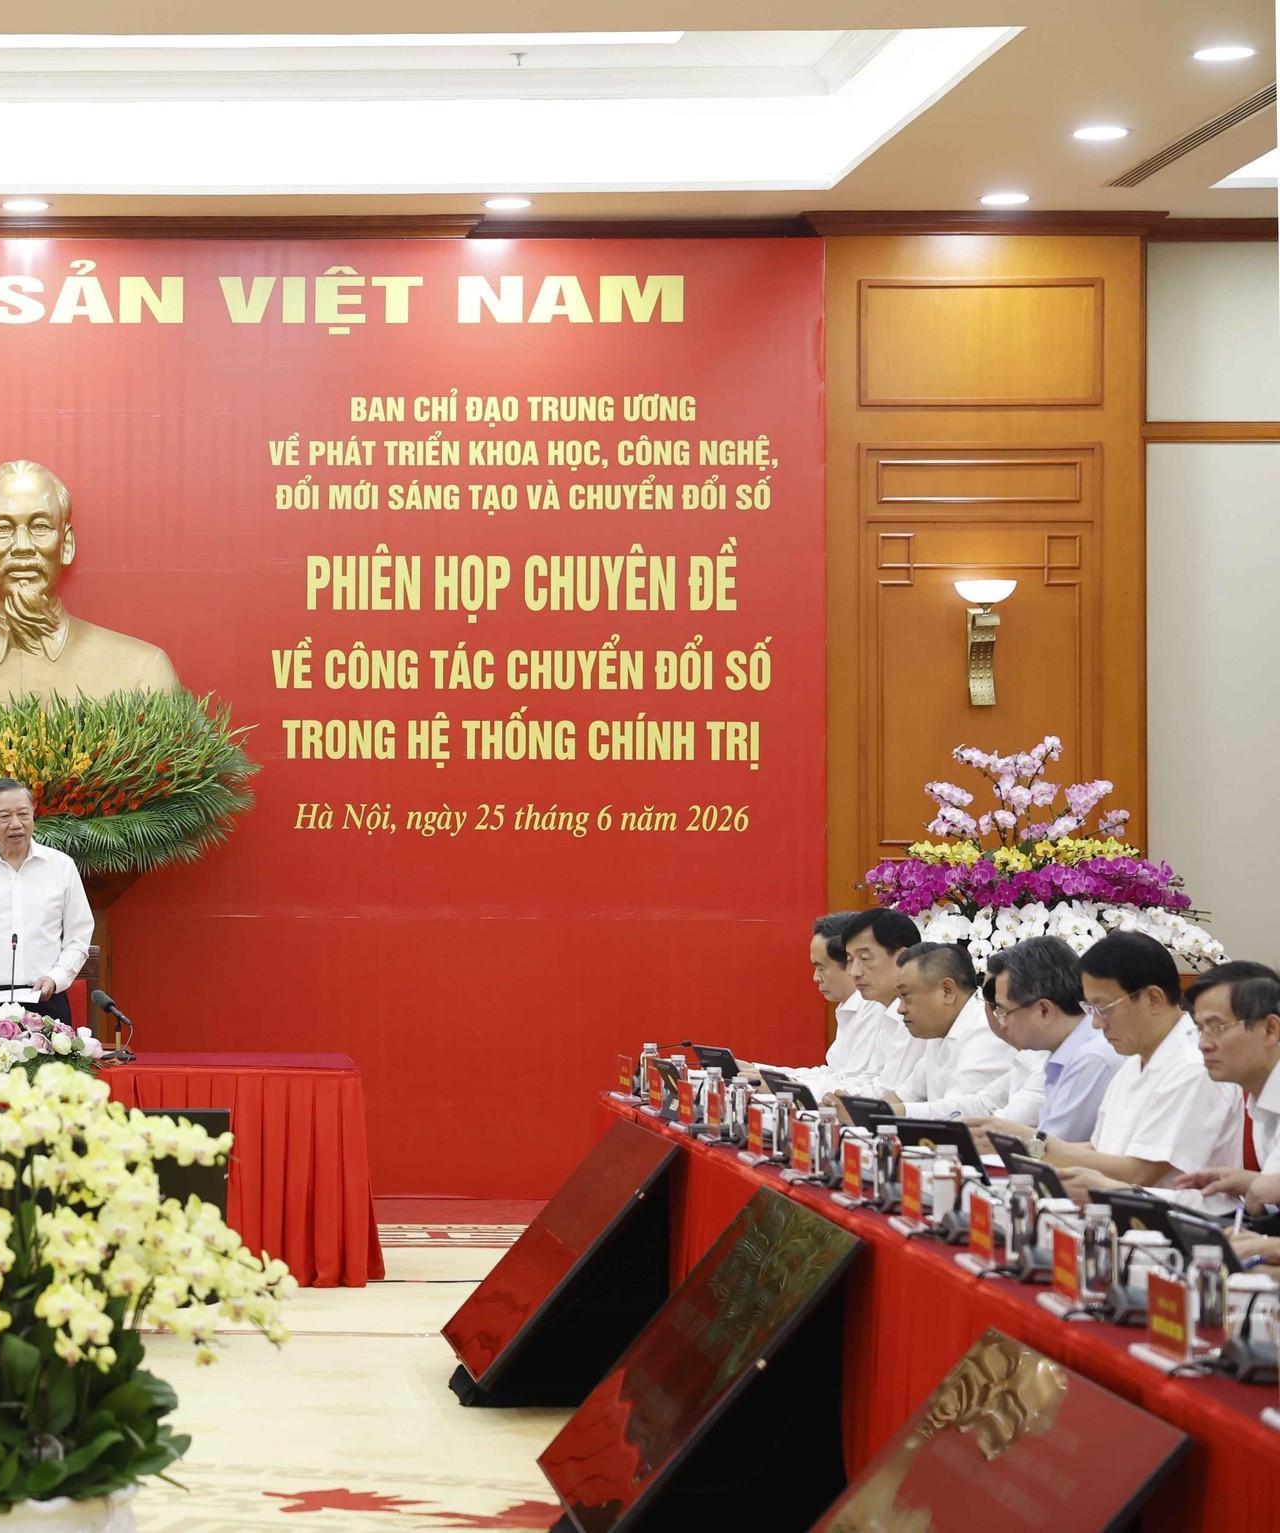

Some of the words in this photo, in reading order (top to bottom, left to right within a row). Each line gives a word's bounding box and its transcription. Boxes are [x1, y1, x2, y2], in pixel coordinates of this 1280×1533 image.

[220, 266, 423, 335] VIỆT
[458, 275, 685, 324] NAM
[351, 397, 404, 421] BAN
[414, 388, 458, 422] CHỈ
[465, 396, 518, 427] ĐẠO
[527, 396, 614, 421] TRUNG
[624, 394, 695, 421] ƯƠNG
[269, 432, 299, 465] VỀ
[309, 436, 376, 465] PHÁT
[384, 431, 459, 465] TRIỂN
[469, 441, 539, 466] KHOA
[548, 440, 608, 471] HỌC,
[618, 435, 689, 465] CÔNG
[700, 435, 778, 471] NGHỆ,
[275, 475, 319, 510] ĐỔI
[329, 480, 378, 510] MỚI
[388, 480, 459, 510] SÁNG
[469, 485, 517, 515] TẠO
[527, 480, 560, 509] VÀ
[569, 475, 673, 510] CHUYỂN
[682, 475, 726, 509] ĐỔI
[736, 476, 771, 509] SỐ
[307, 544, 420, 610] PHIÊN
[435, 555, 510, 623] HỌP
[525, 544, 675, 611] CHUYÊN
[689, 537, 738, 610] ĐỀ
[272, 637, 312, 688] VỀ
[325, 642, 418, 689] CÔNG
[430, 642, 494, 689] TÁC
[508, 634, 643, 689] CHUYỂN
[655, 635, 712, 690] ĐỔI
[726, 637, 772, 690] SỐ
[283, 720, 395, 759] TRONG
[408, 712, 449, 768] HỆ
[462, 706, 575, 760] THỐNG
[589, 713, 694, 760] CHÍNH
[707, 722, 759, 769] TRỊ
[294, 803, 333, 829] Hà
[342, 803, 395, 836] Nội,
[407, 804, 467, 837] ngày
[475, 804, 504, 830] 25
[515, 804, 589, 838] tháng
[598, 805, 612, 830] 6
[621, 806, 676, 831] năm
[686, 805, 749, 831] 2026
